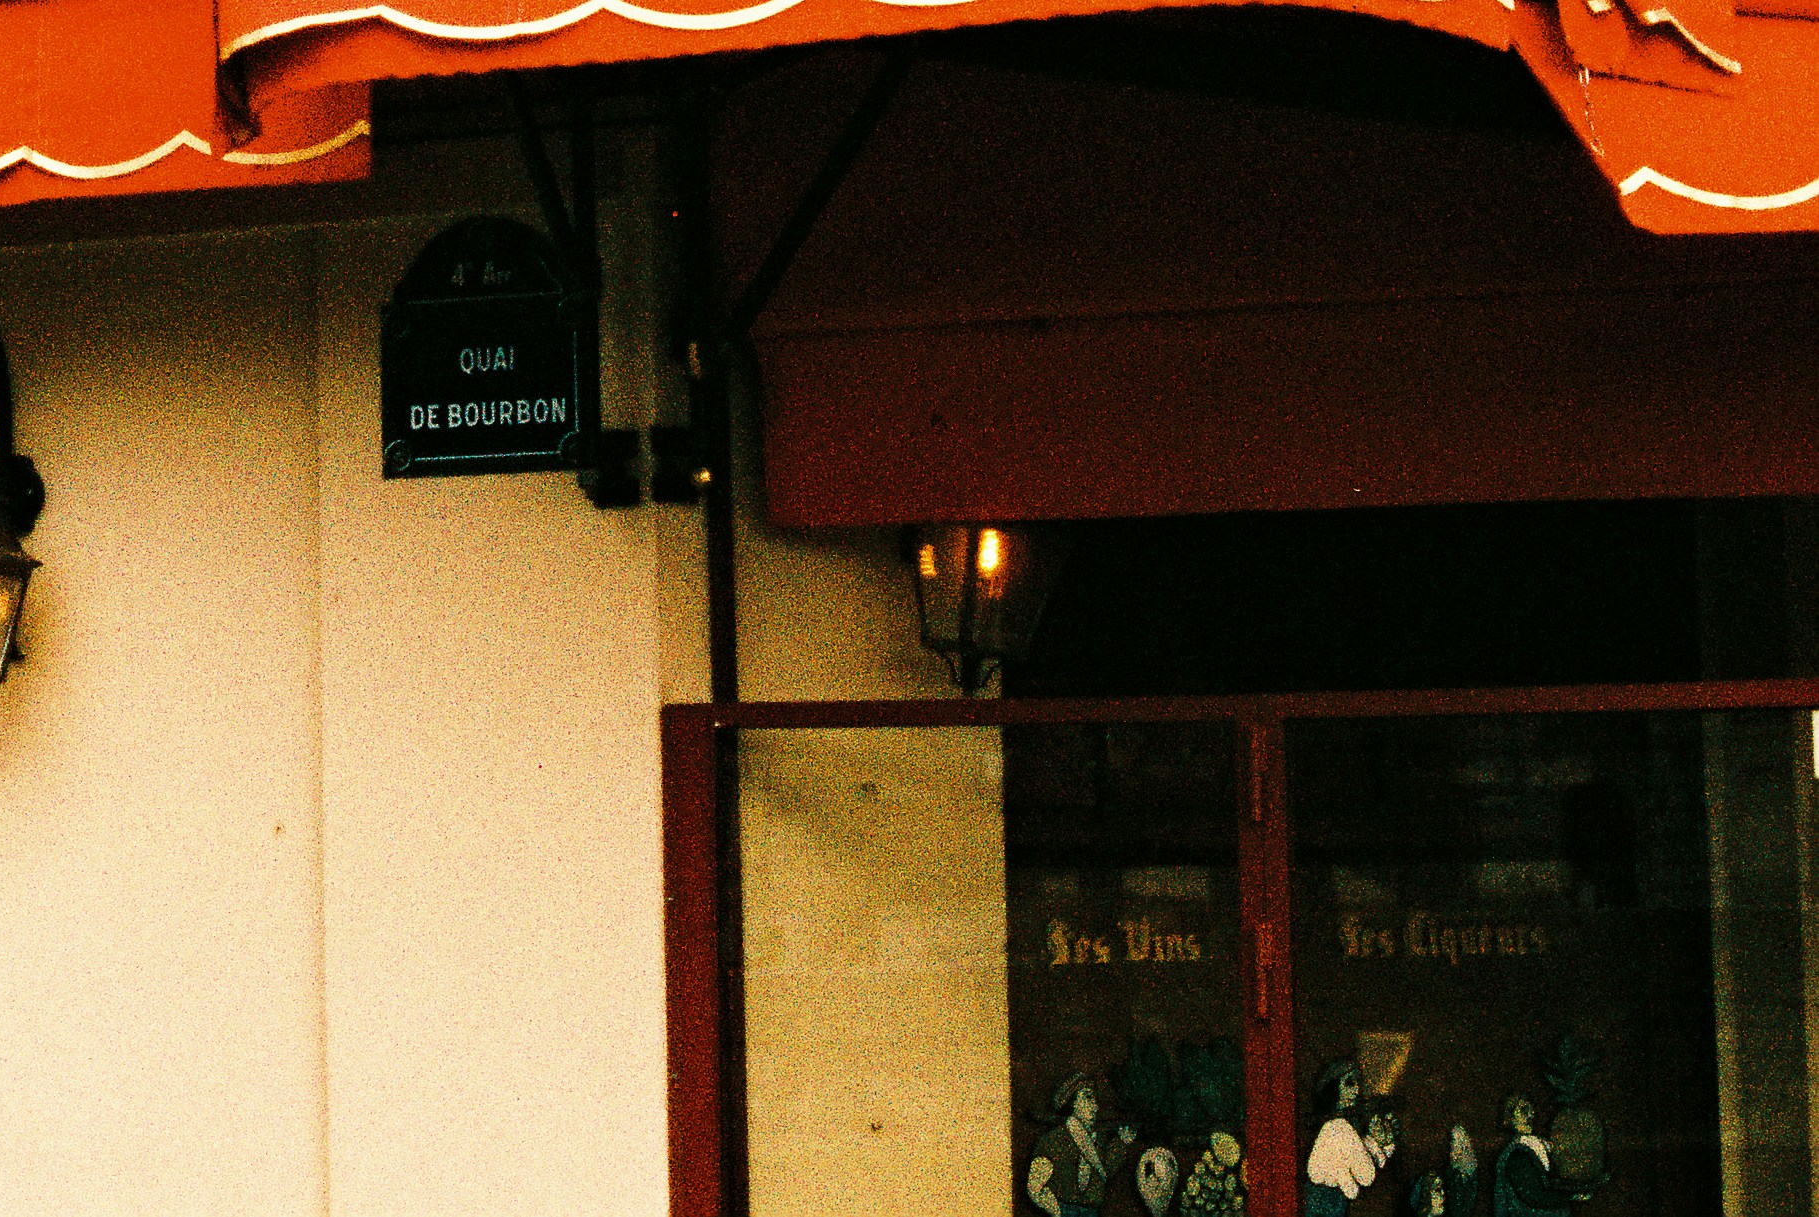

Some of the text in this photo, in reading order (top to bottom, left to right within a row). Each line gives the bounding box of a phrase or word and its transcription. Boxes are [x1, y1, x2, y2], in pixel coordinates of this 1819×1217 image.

[459, 346, 514, 375] QUAI
[410, 397, 566, 429] DE BOURBON
[1118, 915, 1202, 964] Vins
